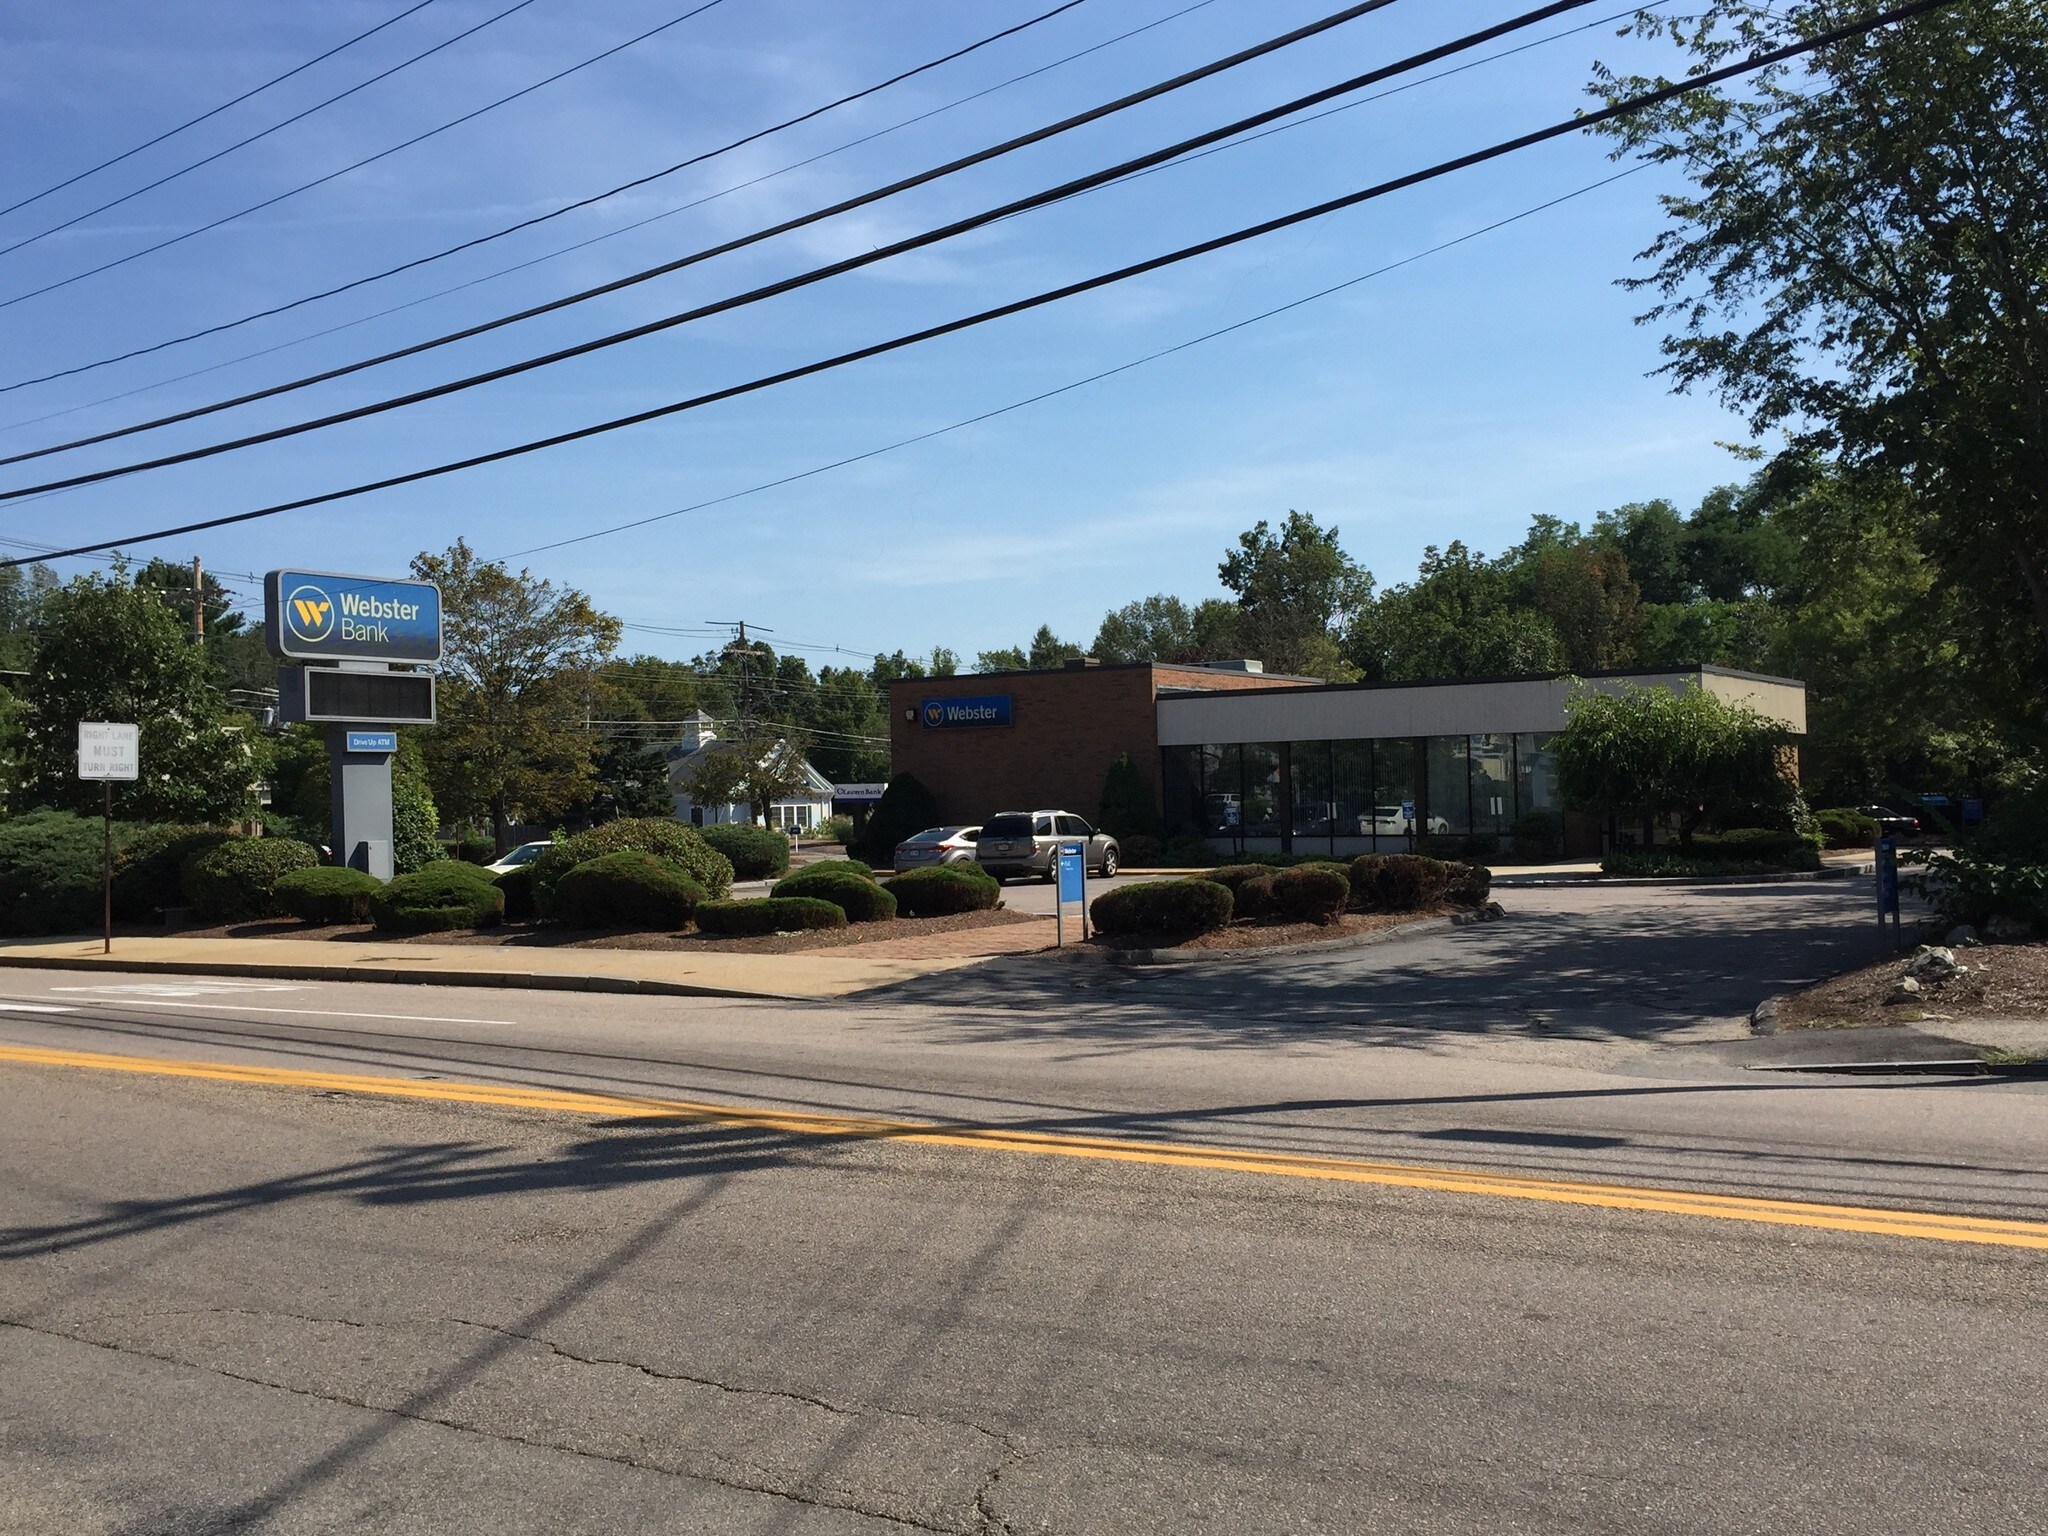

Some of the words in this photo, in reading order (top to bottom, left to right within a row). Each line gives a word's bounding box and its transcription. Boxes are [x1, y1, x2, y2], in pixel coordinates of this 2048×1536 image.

[340, 592, 420, 621] Webster
[341, 618, 390, 642] Bank
[947, 705, 998, 721] Webster
[83, 730, 109, 740] RIGHT
[112, 731, 134, 741] LANE
[353, 738, 368, 746] Drive
[367, 738, 377, 747] Up
[377, 738, 390, 746] ATM
[93, 745, 125, 757] MUST
[83, 762, 106, 772] TURN
[109, 763, 134, 772] RIGHT
[865, 788, 882, 796] Bank
